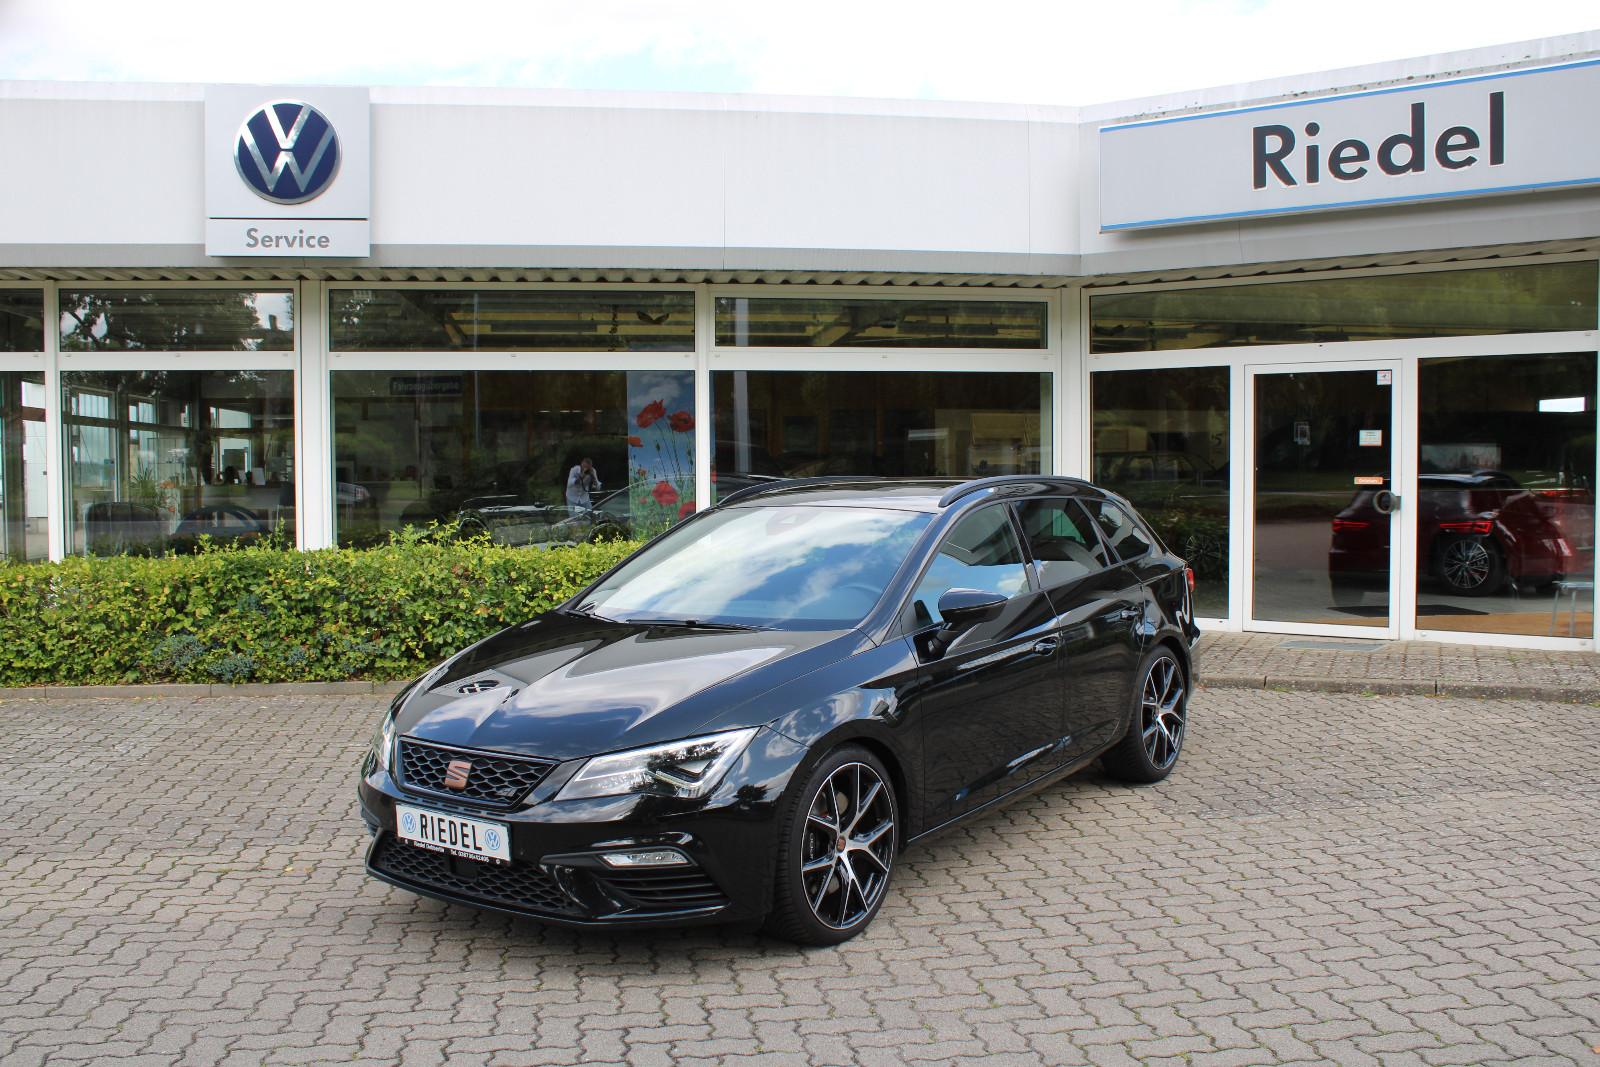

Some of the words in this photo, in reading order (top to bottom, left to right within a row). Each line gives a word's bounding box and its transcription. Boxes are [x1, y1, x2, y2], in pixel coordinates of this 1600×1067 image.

[1253, 91, 1504, 190] Riedel
[246, 228, 330, 248] Service
[420, 814, 482, 851] RIEDEL
